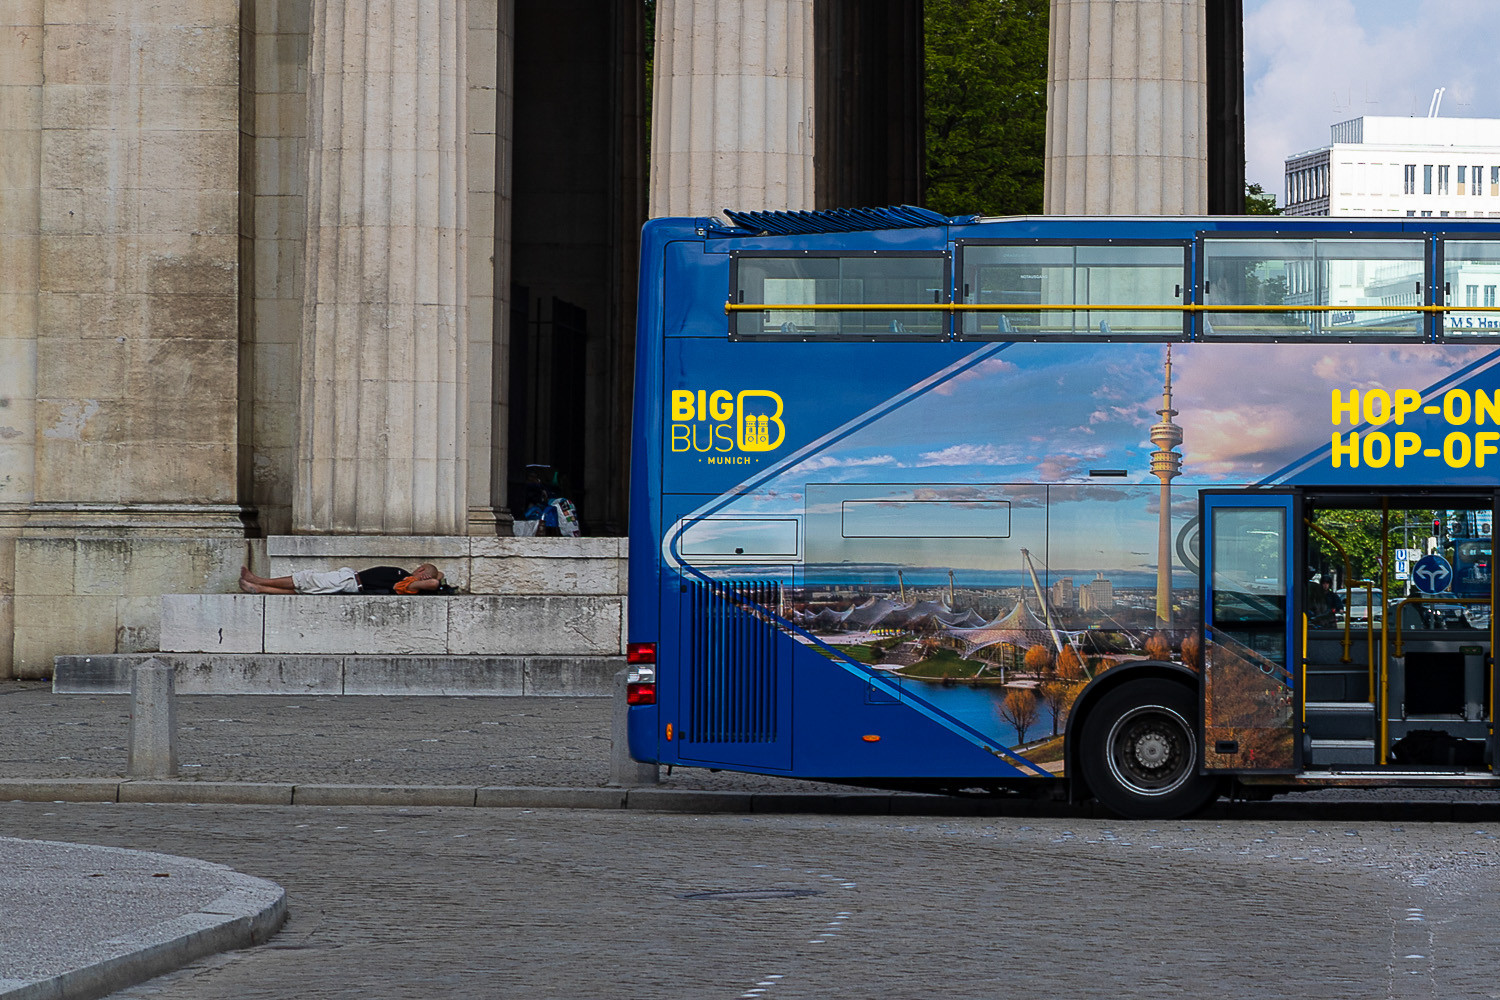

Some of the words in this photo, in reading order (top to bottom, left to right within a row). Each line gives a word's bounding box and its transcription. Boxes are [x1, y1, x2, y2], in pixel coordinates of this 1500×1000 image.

[672, 390, 733, 421] BIG
[672, 424, 733, 452] BUS
[707, 456, 751, 465] MUNICH
